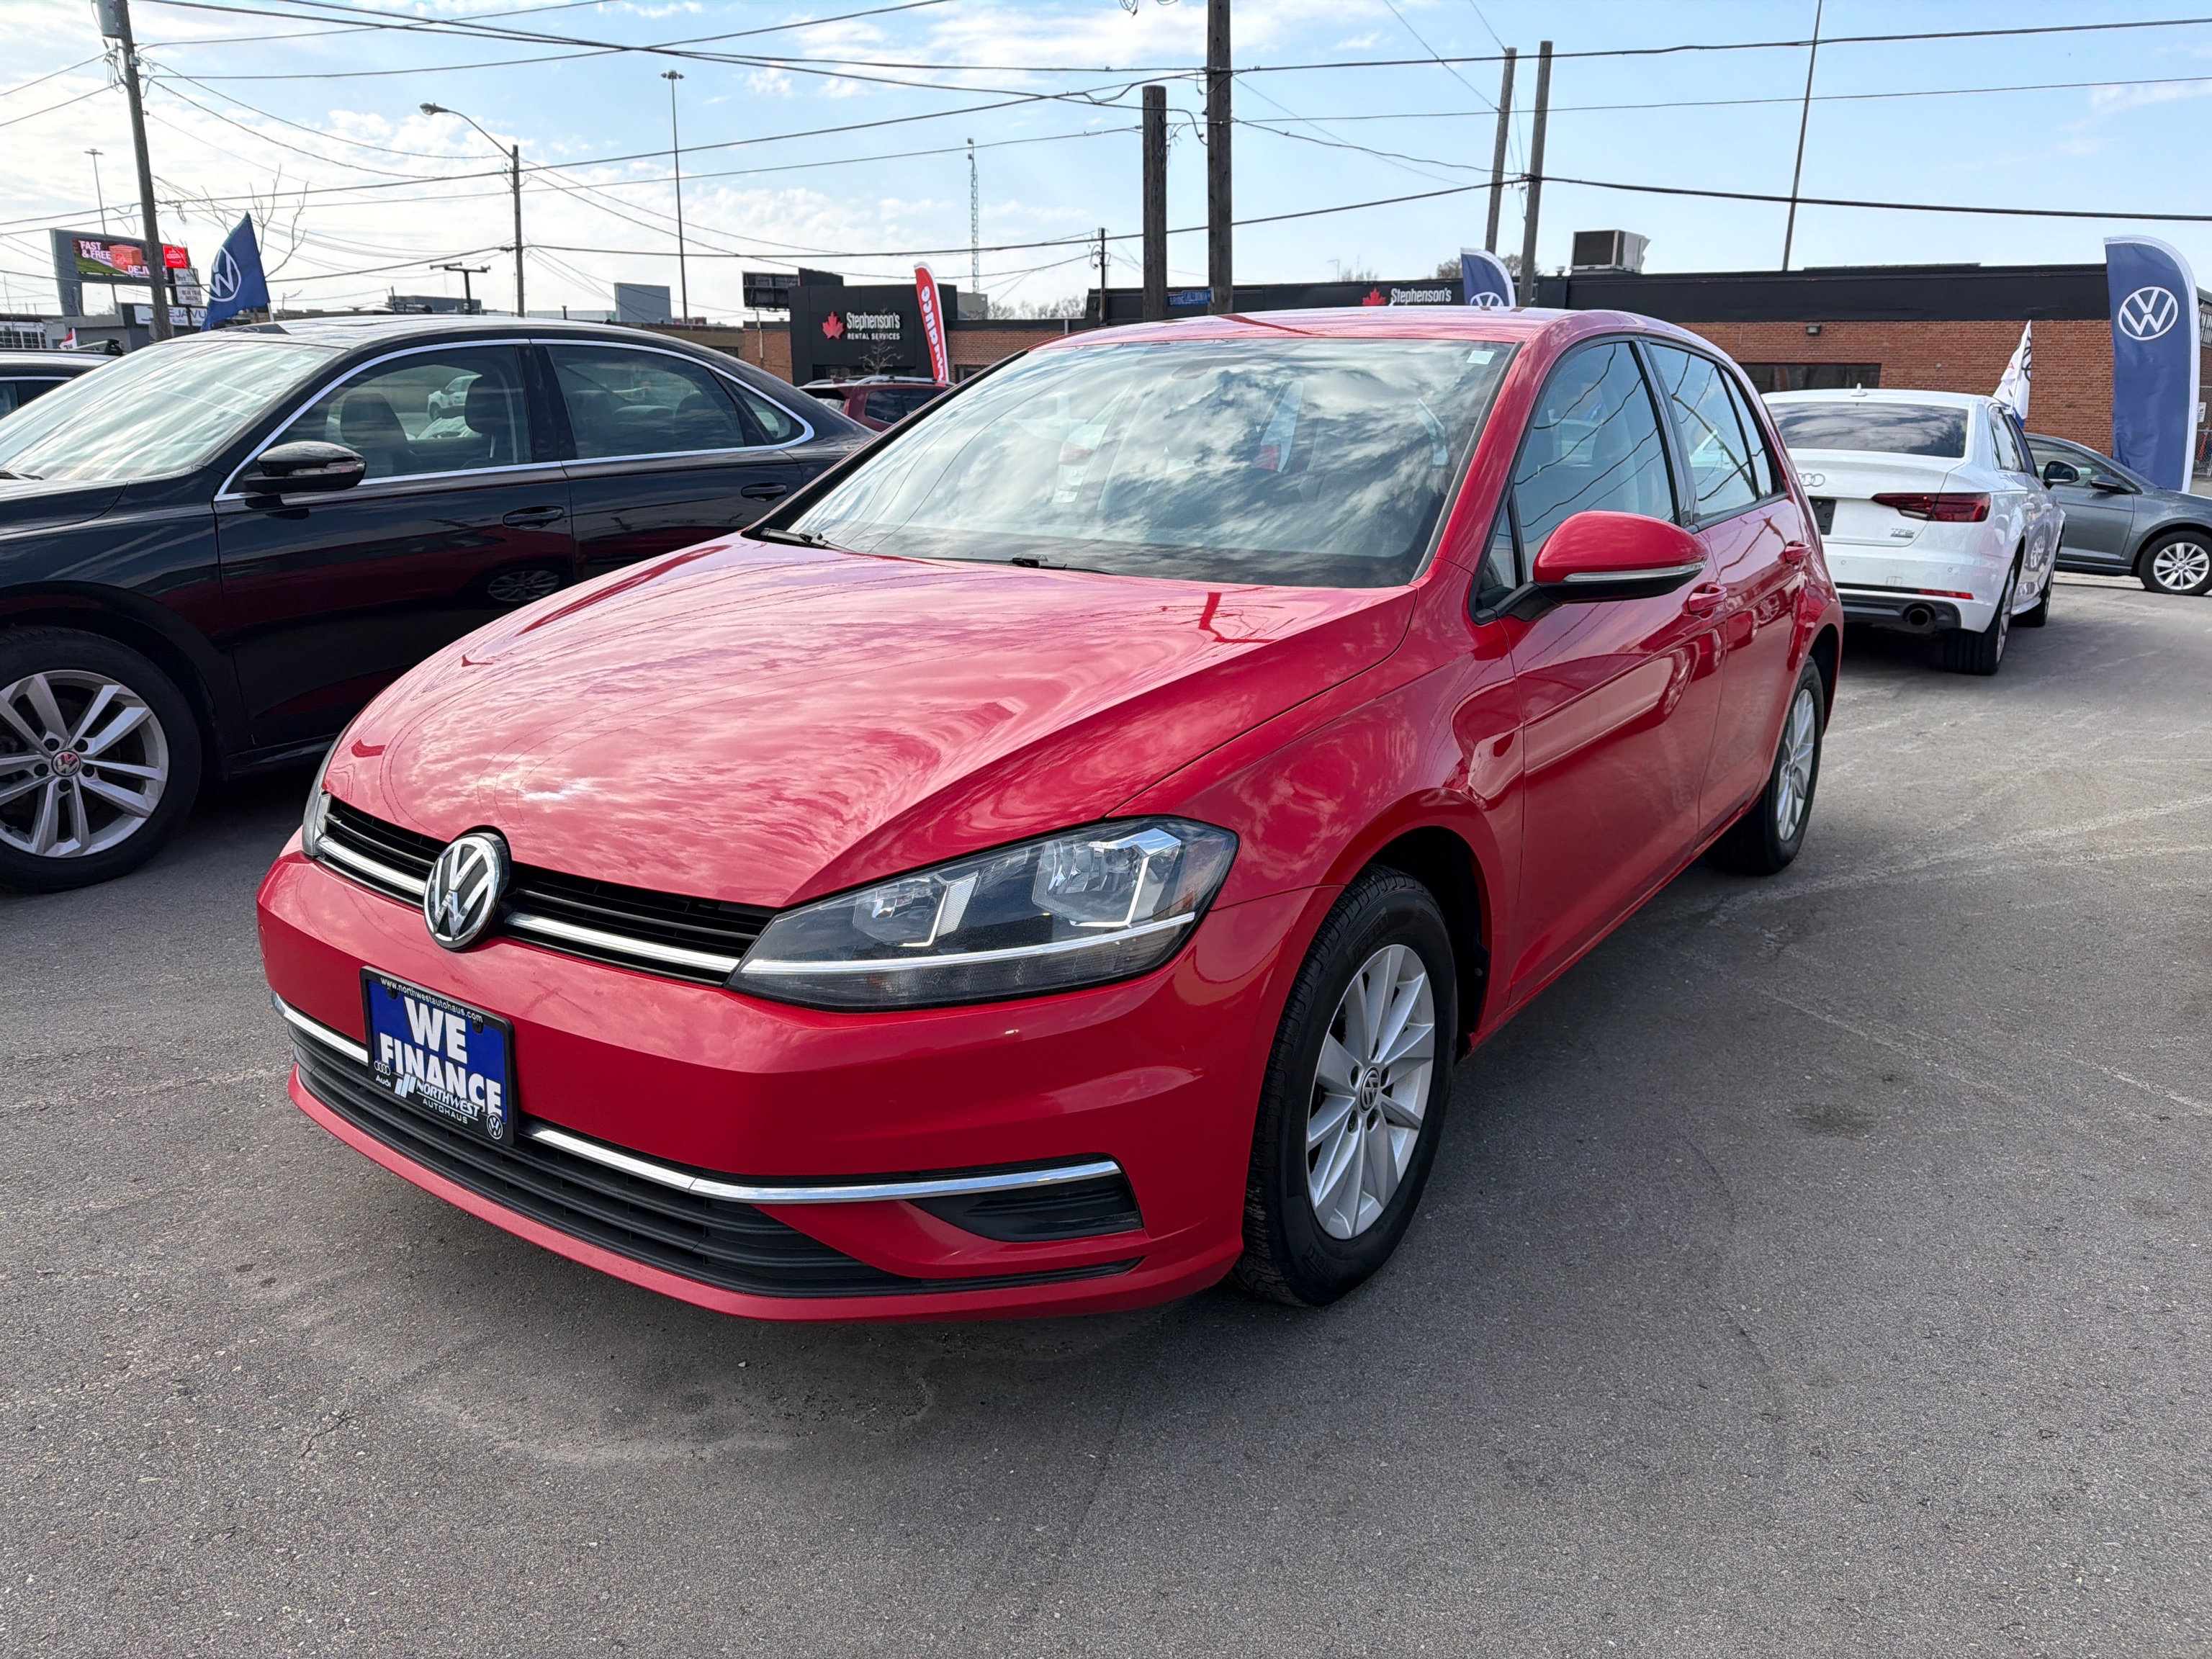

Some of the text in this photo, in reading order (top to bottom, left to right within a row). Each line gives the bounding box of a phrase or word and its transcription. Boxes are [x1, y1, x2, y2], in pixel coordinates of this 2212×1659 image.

[78, 240, 102, 250] FAST
[81, 250, 112, 260] & FREE
[1390, 287, 1452, 305] Stephenson's
[846, 311, 900, 331] Stephenson's
[380, 977, 483, 1023] www.northwestautohaus.com
[404, 997, 468, 1064] WE
[379, 1033, 503, 1118] FINANCE
[416, 1079, 480, 1118] NORTHWEST
[423, 1098, 468, 1125] AUTOHAUS
